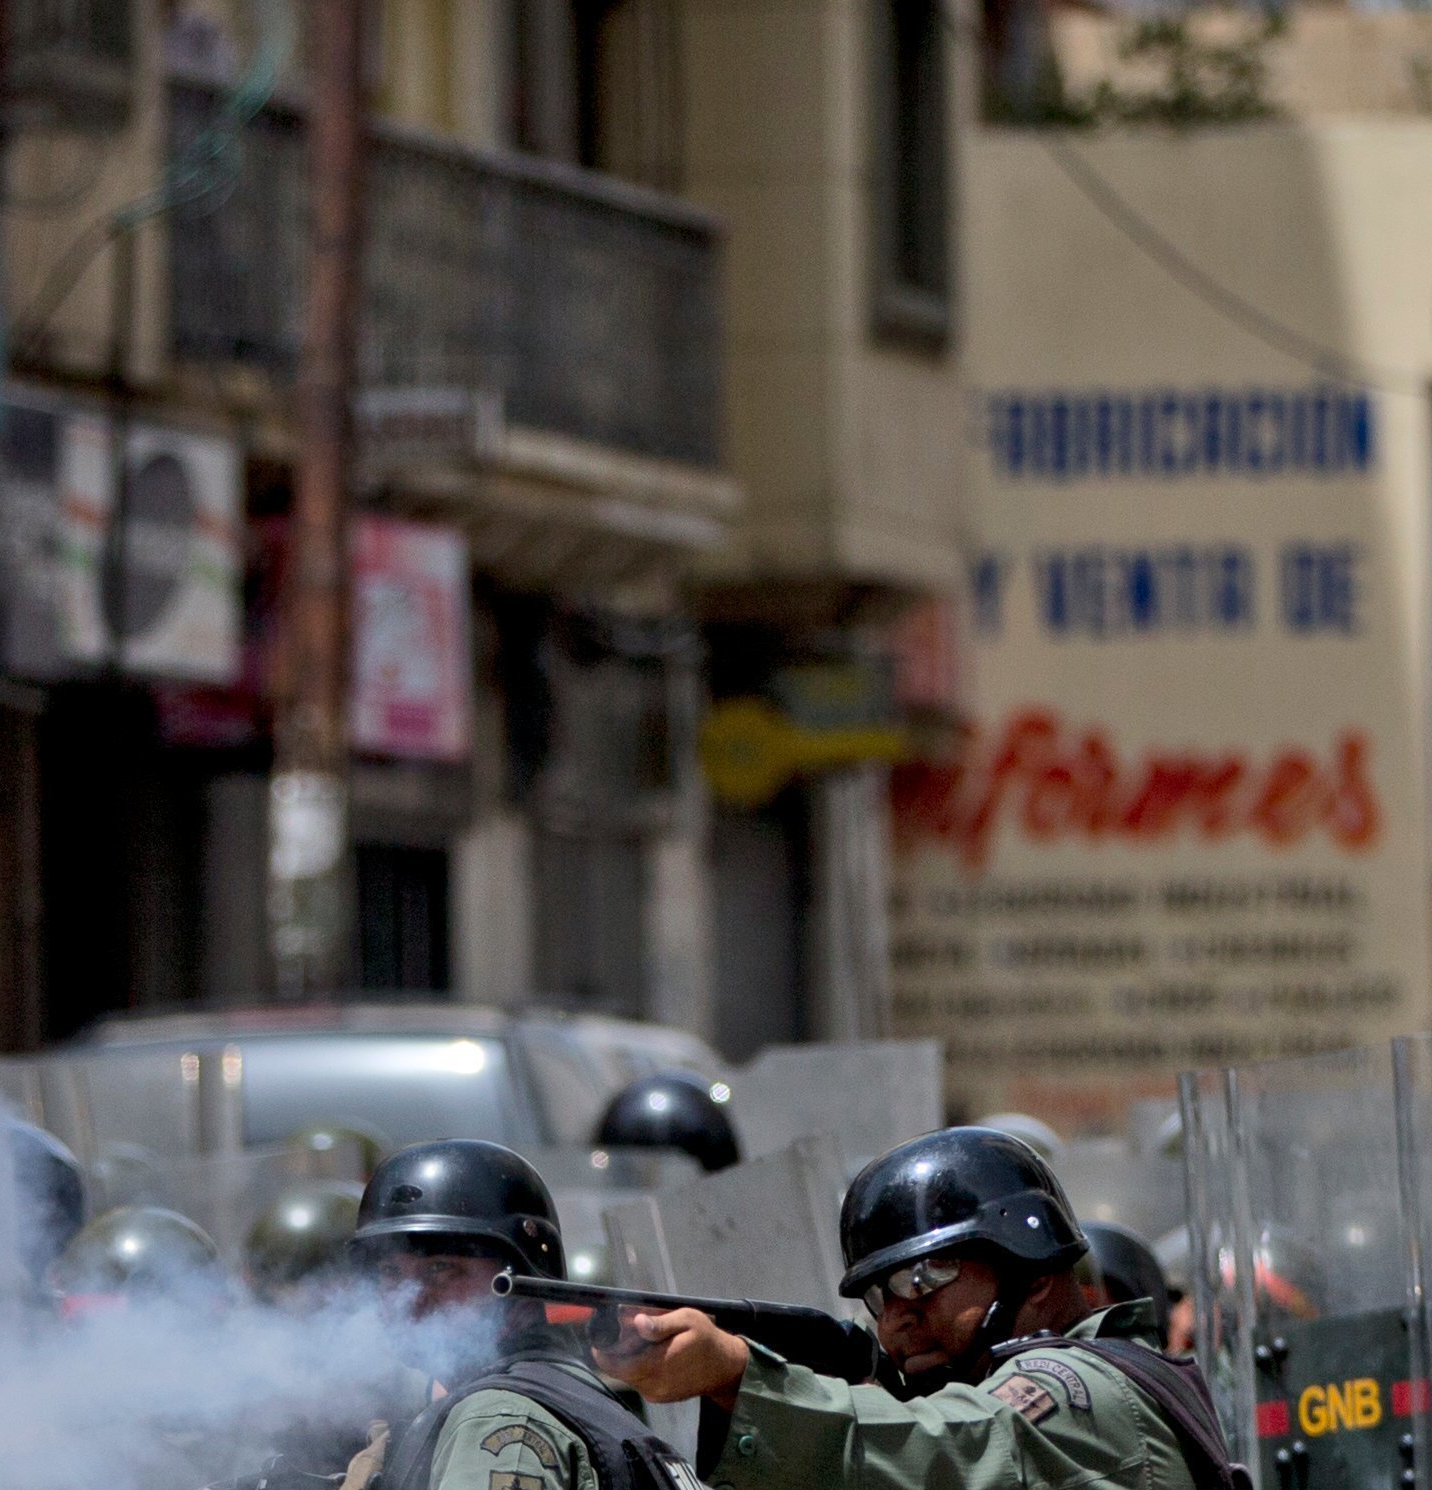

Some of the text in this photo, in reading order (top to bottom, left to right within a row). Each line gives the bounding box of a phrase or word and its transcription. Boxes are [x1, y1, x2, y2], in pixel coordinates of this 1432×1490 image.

[1035, 550, 1257, 636] VENTA
[1279, 543, 1362, 637] DE
[1298, 1378, 1382, 1437] GNB
